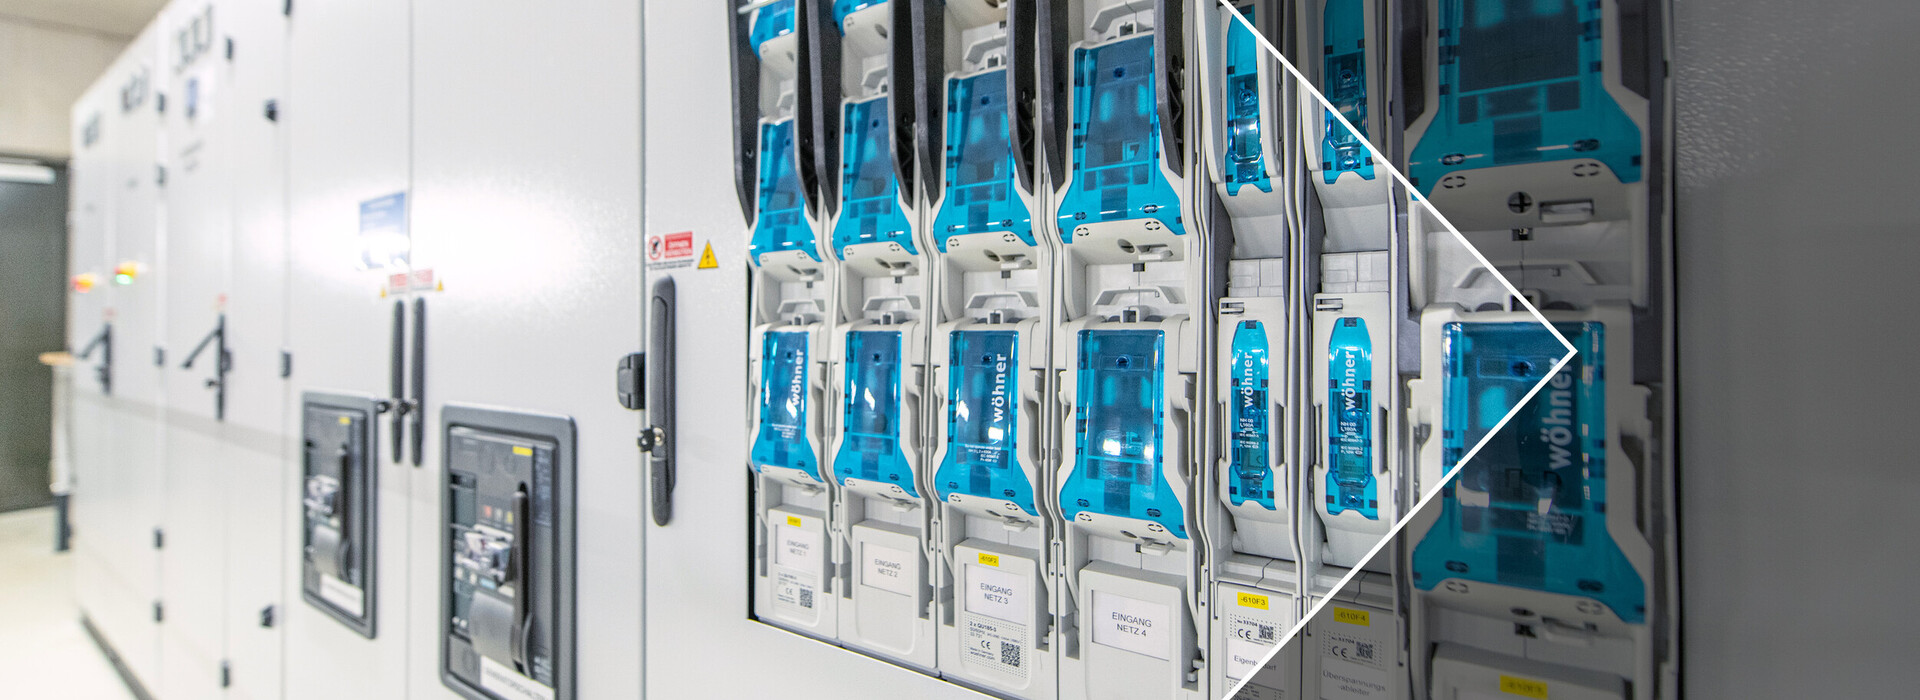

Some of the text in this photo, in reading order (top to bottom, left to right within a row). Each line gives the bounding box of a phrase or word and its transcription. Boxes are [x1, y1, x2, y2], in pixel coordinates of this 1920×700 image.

[790, 348, 804, 406] wöhner
[1240, 352, 1254, 408] wöhner
[1341, 350, 1356, 411] wöhner
[991, 353, 1007, 423] wöhner
[787, 540, 809, 550] EINGANG
[874, 558, 901, 570] EINGANG
[878, 568, 893, 577] NETZ
[980, 582, 1013, 596] EINGANG
[984, 593, 1002, 603] NETZ
[1240, 597, 1266, 606] -610F3
[1112, 612, 1152, 627] EINGANG
[1117, 624, 1139, 635] NETZ
[1234, 655, 1276, 670] Eigenbdarf
